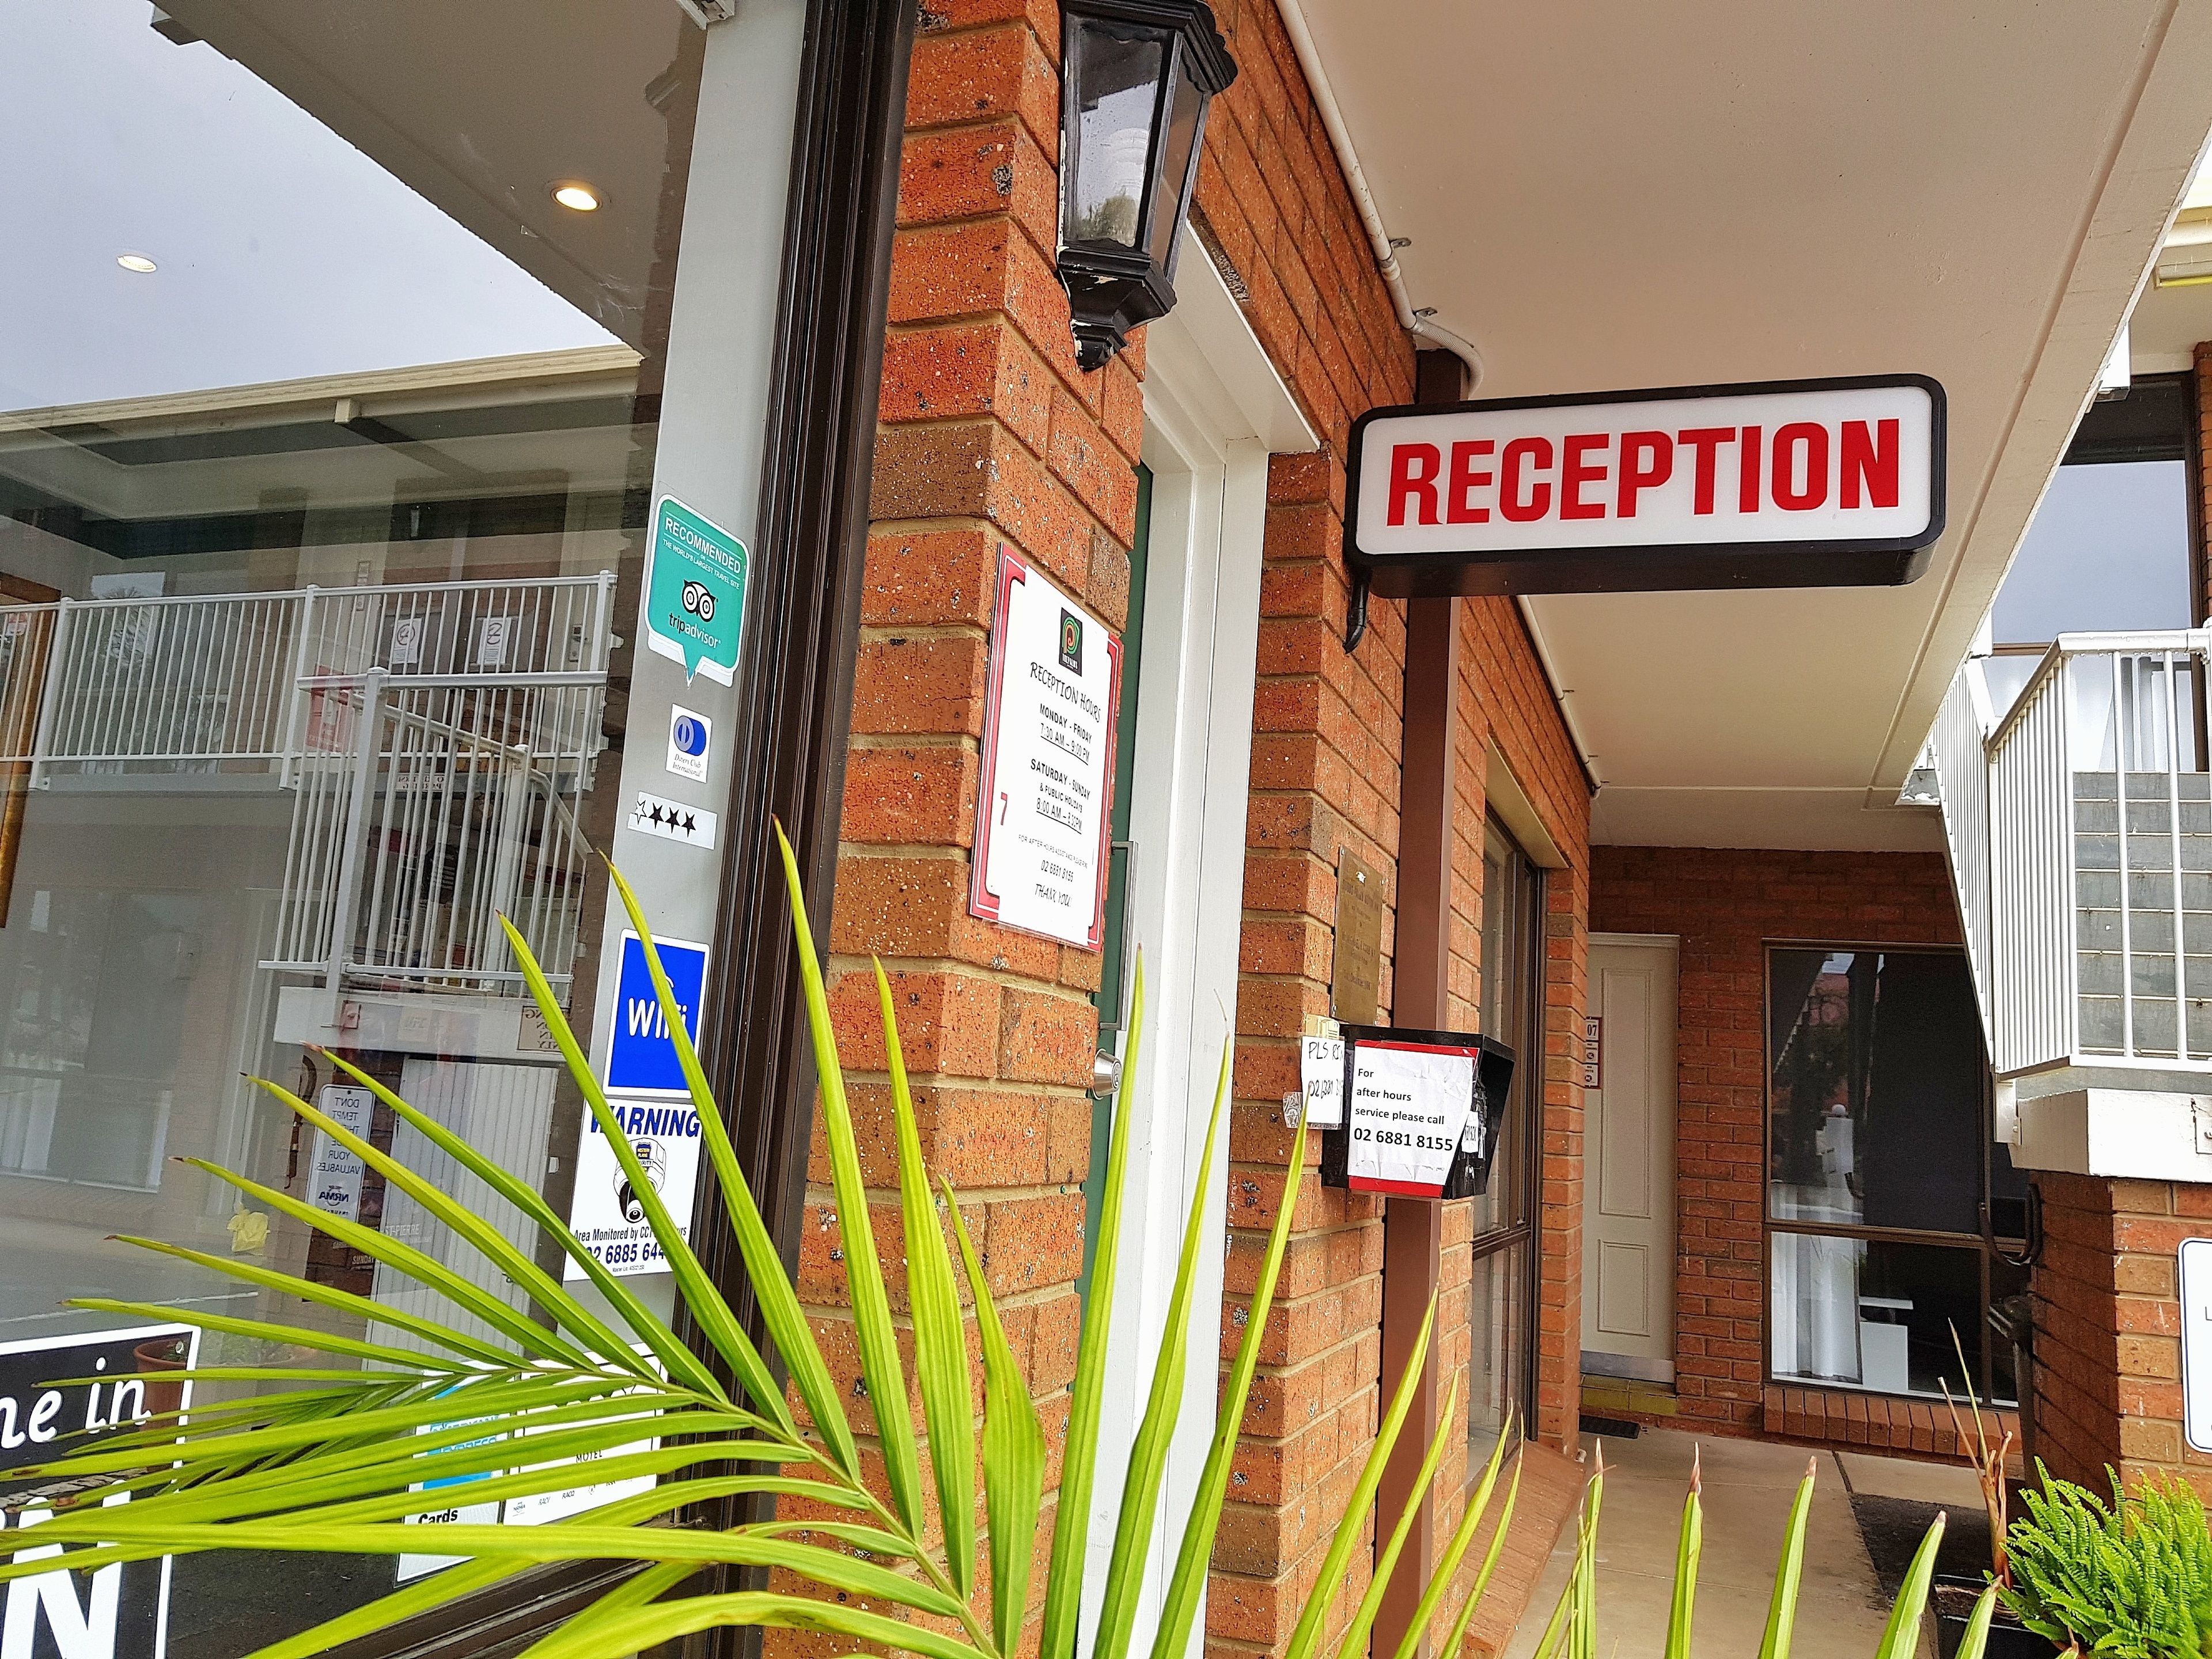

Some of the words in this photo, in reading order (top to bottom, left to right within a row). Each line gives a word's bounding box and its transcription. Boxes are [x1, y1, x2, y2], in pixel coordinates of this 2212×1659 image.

[1386, 418, 1900, 526] RECEPTION
[665, 516, 741, 574] RECOMMENDED
[662, 538, 673, 550] THE
[673, 544, 694, 563] WORLD'S
[693, 557, 714, 574] LARGEST
[714, 569, 730, 584] TRAVEL
[730, 579, 740, 590] SITE
[669, 612, 718, 649] tripadvisor
[1030, 661, 1078, 705] RECEPTION
[1080, 692, 1101, 724] HOURS
[1039, 703, 1067, 729] MONDAY
[1073, 722, 1092, 744] FRIDAY
[1040, 722, 1053, 740] 7:30
[1055, 731, 1065, 747] AM
[1082, 747, 1090, 763] PM
[1030, 758, 1068, 785] SATURDAY
[1072, 779, 1090, 800] SUNDAY
[1039, 782, 1044, 791] &
[1044, 785, 1064, 801] PUBLIC
[1036, 797, 1050, 814] 8:00
[1051, 804, 1062, 819] AM
[1040, 859, 1049, 872] 02
[1062, 868, 1074, 882] 8155
[1035, 883, 1057, 903] THANK
[1587, 1024, 1597, 1036] 07
[1308, 1041, 1329, 1059] PLS
[1357, 1067, 1374, 1078] For
[1356, 1087, 1381, 1097] after
[1382, 1090, 1412, 1102] hours
[1355, 1108, 1390, 1119] service
[1392, 1111, 1425, 1126] please
[1426, 1115, 1445, 1125] call
[1354, 1127, 1372, 1142] 02
[1376, 1130, 1412, 1147] 6881
[1416, 1134, 1453, 1152] 8155
[574, 1229, 590, 1243] Area
[592, 1227, 629, 1242] Monitored
[630, 1226, 639, 1241] by
[639, 1226, 653, 1238] CCT
[605, 1243, 638, 1264] 6885
[642, 1242, 665, 1261] 644
[85, 1356, 151, 1434] in
